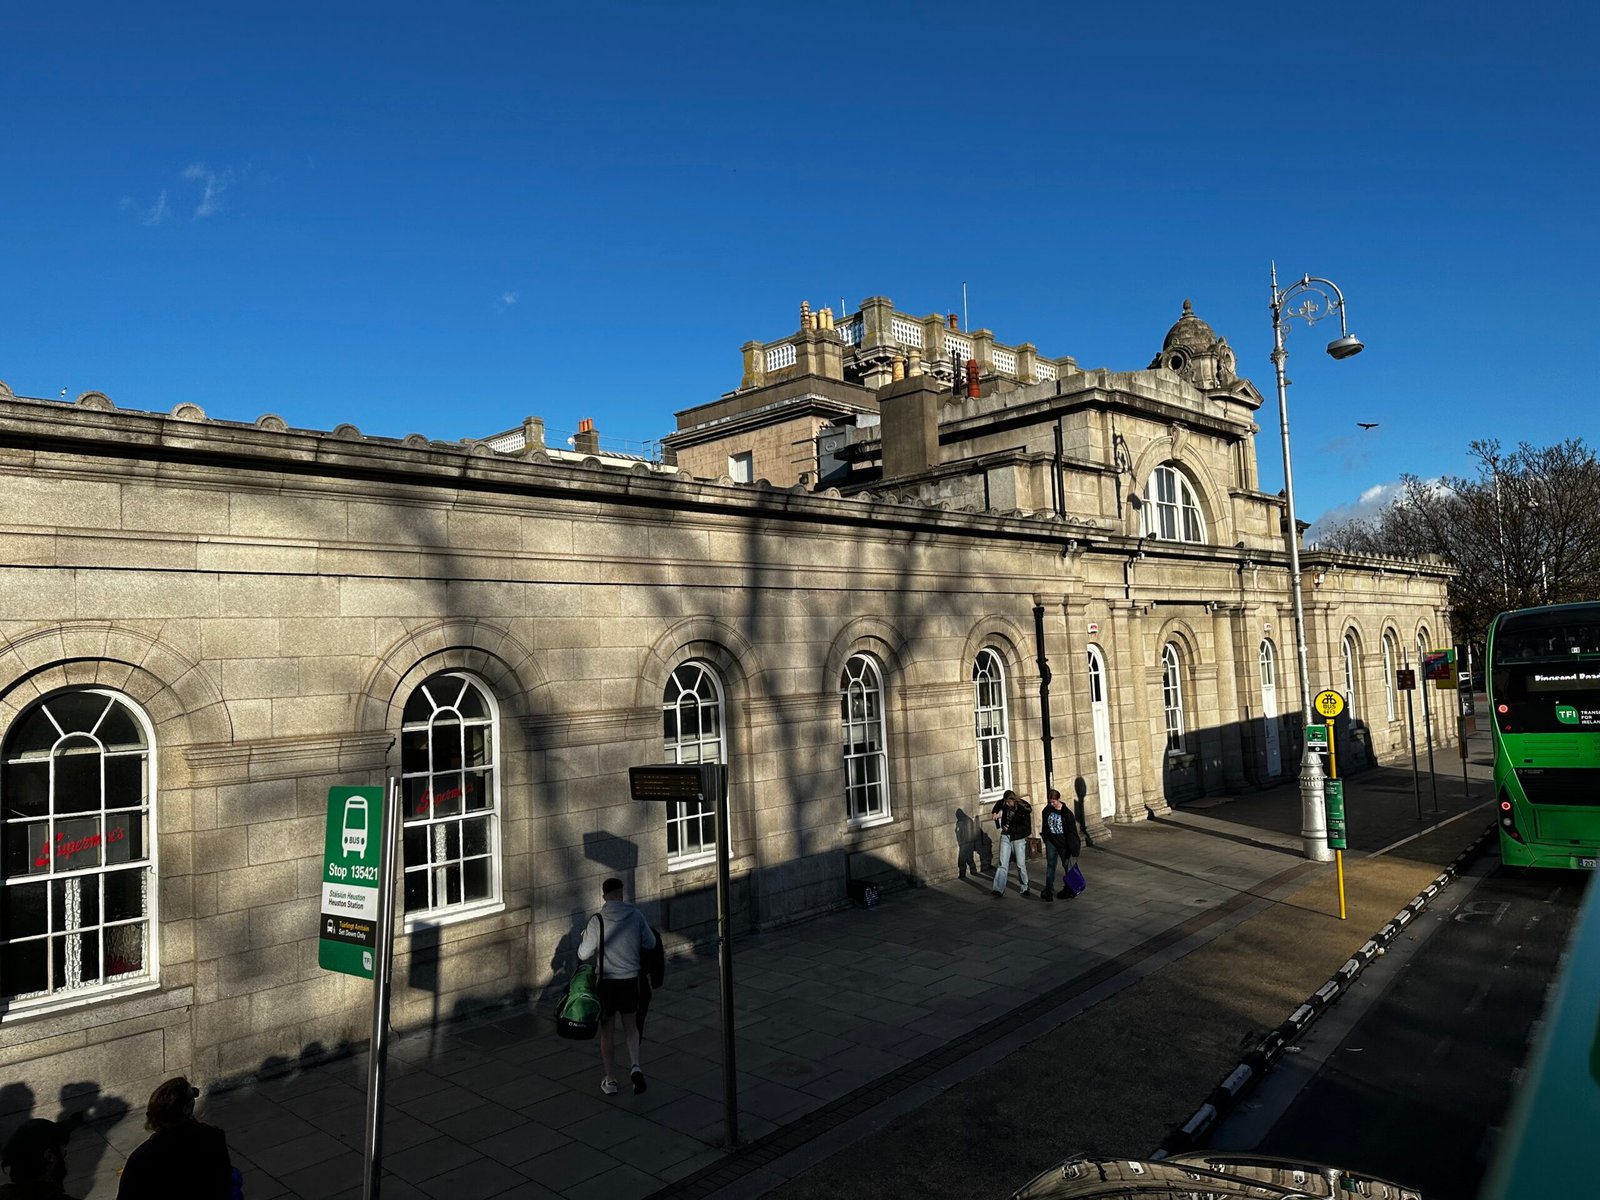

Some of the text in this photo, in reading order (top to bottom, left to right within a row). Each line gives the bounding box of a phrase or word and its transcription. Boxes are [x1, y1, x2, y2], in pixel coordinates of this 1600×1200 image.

[349, 836, 361, 845] BUS
[34, 826, 125, 867] Supermc's
[329, 862, 378, 881] Stop 135421
[347, 891, 366, 902] Heuston
[328, 898, 364, 910] Heuston Station
[345, 930, 357, 938] Down
[357, 931, 367, 940] Only
